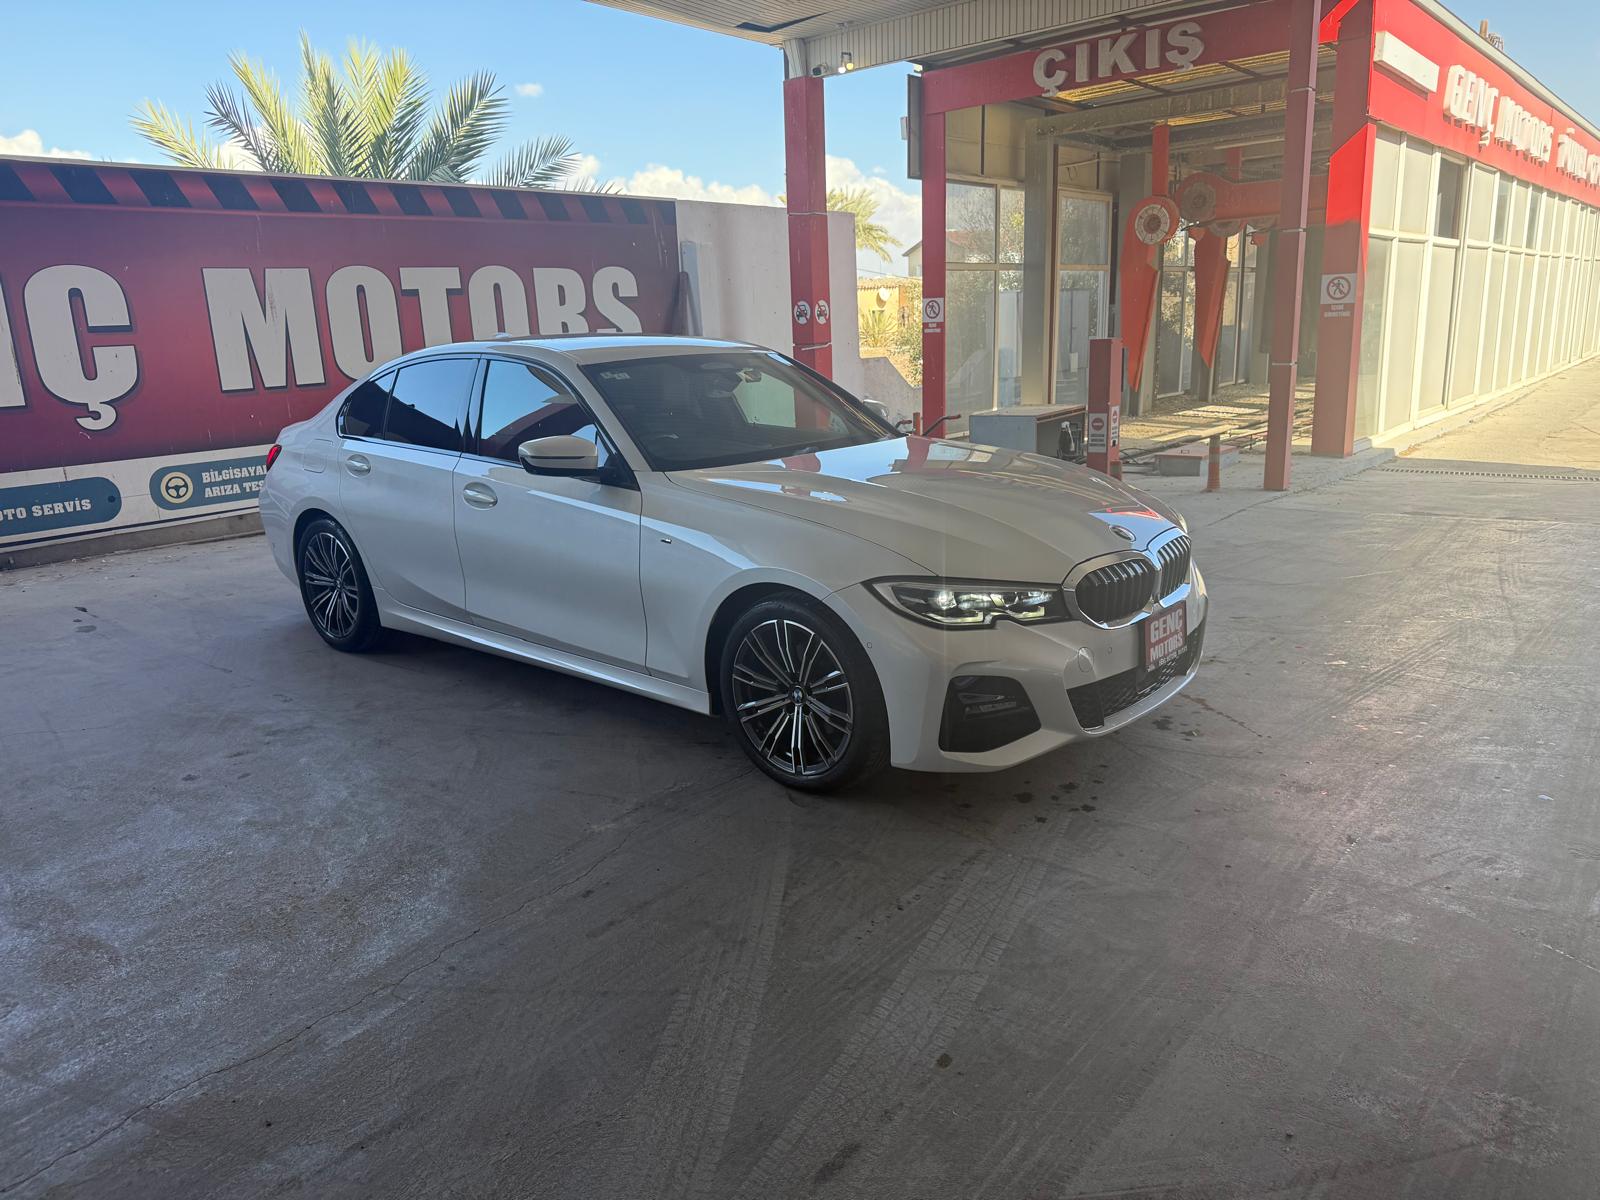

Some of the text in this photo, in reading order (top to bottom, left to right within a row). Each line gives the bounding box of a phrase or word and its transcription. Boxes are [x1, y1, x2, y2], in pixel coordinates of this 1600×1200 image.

[1033, 22, 1205, 97] ÇIKIŞ
[1444, 64, 1499, 146] GENÇ
[1494, 96, 1555, 162] MOTORS
[202, 265, 643, 393] MOTORS
[32, 497, 92, 517] SERVİS
[204, 484, 241, 498] ARIZA
[1150, 608, 1183, 643] GENÇ
[1150, 632, 1183, 662] MOTORS
